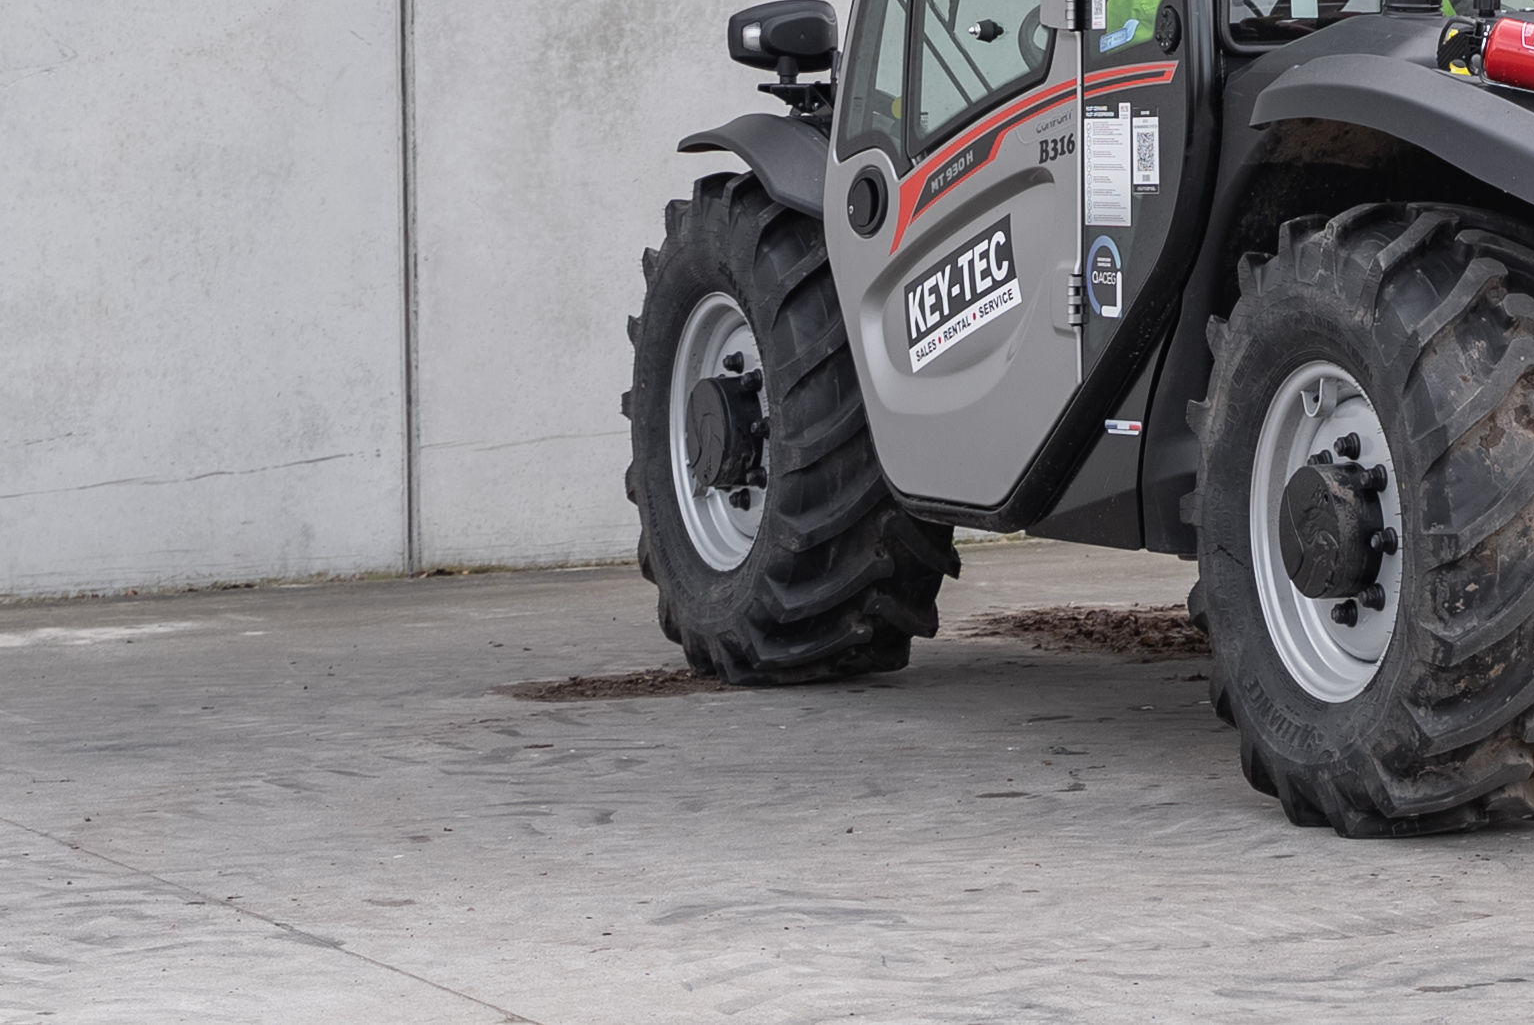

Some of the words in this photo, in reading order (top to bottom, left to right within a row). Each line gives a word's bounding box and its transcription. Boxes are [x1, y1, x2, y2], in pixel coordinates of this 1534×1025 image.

[930, 176, 945, 194] MT
[945, 158, 964, 182] 930
[965, 149, 974, 166] H
[1038, 133, 1076, 164] B316
[908, 230, 1009, 340] KEY-TEC
[915, 338, 937, 362] SALES
[943, 315, 972, 342] RENTAL
[978, 288, 1014, 318] SERVICE
